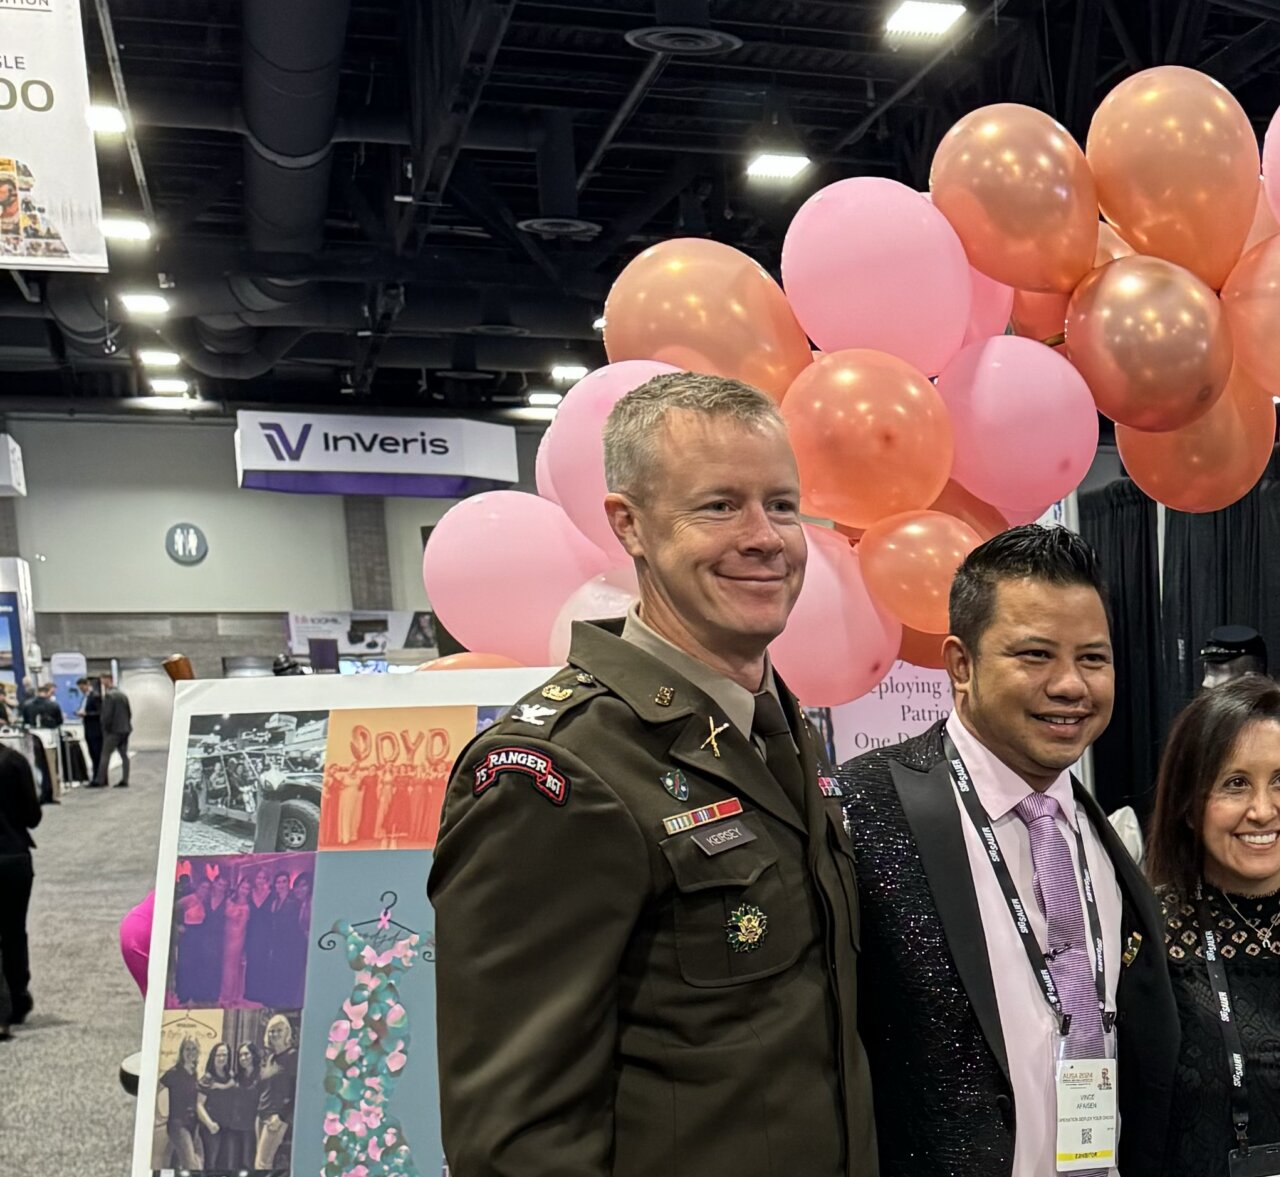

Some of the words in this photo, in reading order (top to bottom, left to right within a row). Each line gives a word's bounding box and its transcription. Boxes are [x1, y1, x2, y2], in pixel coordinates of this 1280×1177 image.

[322, 431, 450, 456] InVeris
[350, 725, 450, 765] ODYD
[854, 732, 890, 749] One
[489, 751, 547, 774] RANGER
